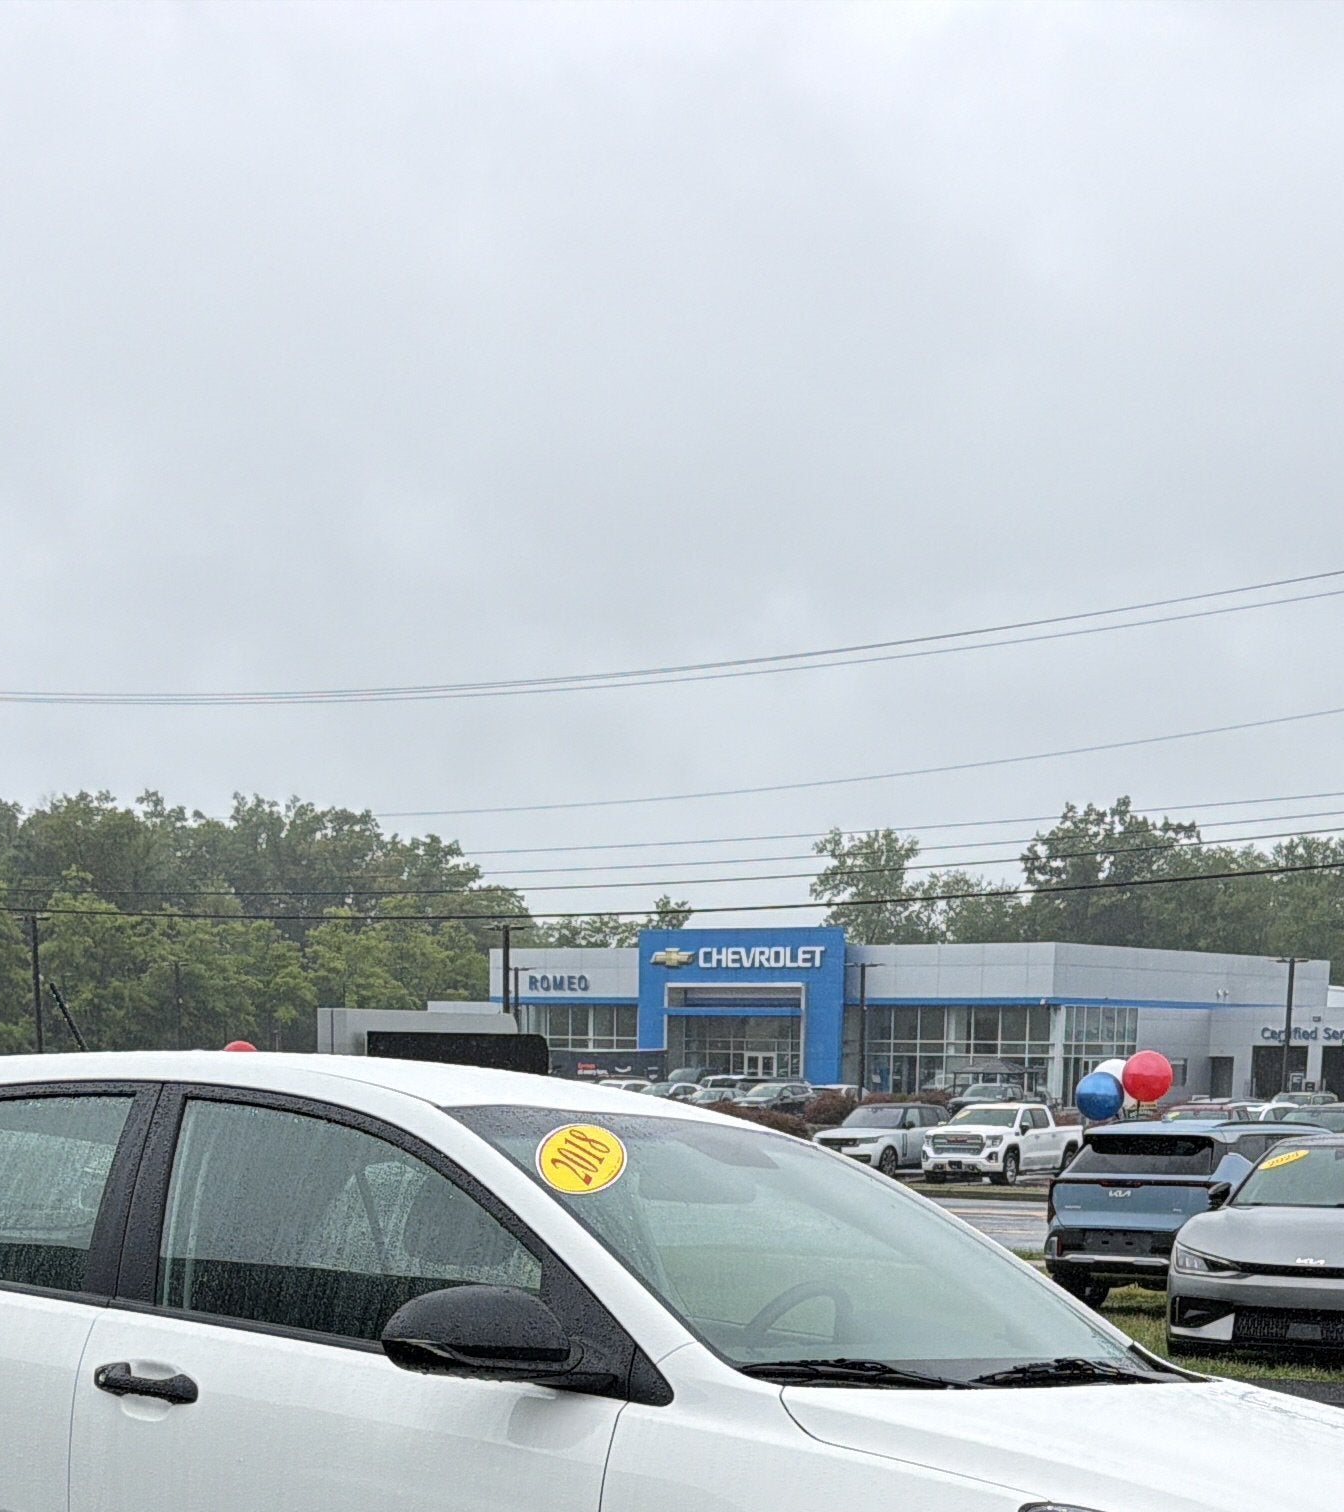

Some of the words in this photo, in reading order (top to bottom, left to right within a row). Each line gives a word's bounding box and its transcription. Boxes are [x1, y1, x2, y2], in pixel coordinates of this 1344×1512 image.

[698, 946, 825, 968] CHEVROLET
[528, 974, 590, 992] ROMEO
[551, 1129, 611, 1186] 2018
